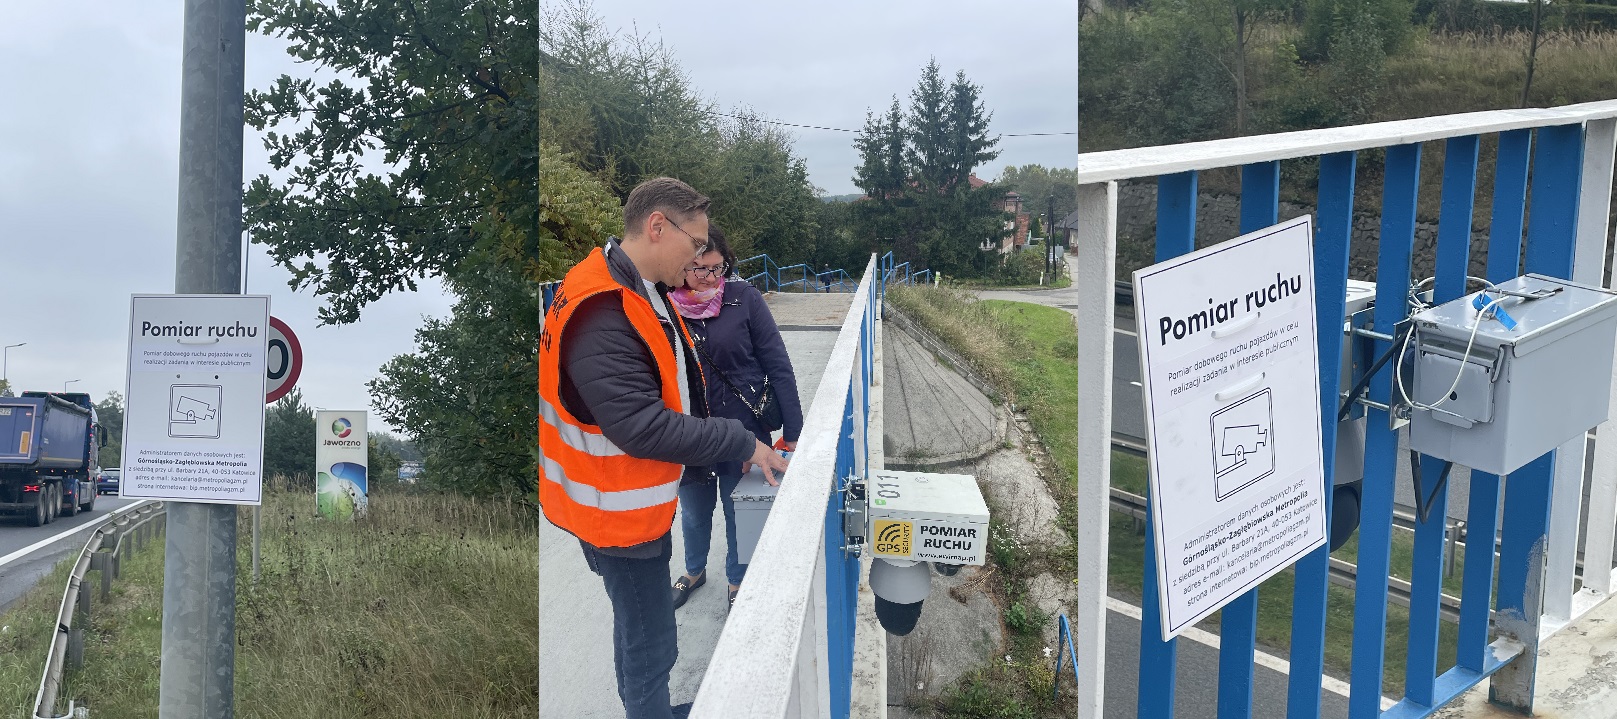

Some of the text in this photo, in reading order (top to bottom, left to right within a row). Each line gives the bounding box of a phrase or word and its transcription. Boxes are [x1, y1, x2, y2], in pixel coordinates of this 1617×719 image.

[1159, 272, 1302, 347] Pomiar ruchu
[141, 320, 258, 337] Pomiar ruchu
[207, 351, 233, 359] pojazdów
[267, 338, 289, 380] 0
[1168, 320, 1299, 382] Pomiar dobowego ruchu pojazdów w celu
[1170, 335, 1299, 397] realizacji zadania w interesie publicznym
[139, 449, 182, 457] Administratorem
[183, 450, 202, 458] danych
[323, 439, 361, 447] Jaworzno
[132, 466, 154, 474] siedzibą
[137, 457, 248, 468] Górnośląsko-Zagłębiowska Metropolia
[1182, 490, 1308, 566] Górnośląsko-Zagłębiowska Metropolia
[1183, 479, 1305, 551] Administratorem danych osobowych jest:
[902, 523, 910, 554] SECURITY
[920, 525, 977, 539] POMIAR
[923, 538, 972, 551] RUCHU
[1172, 497, 1318, 587] z siedzibą przy ul. Barbary 21A, 40-053 Katowice
[876, 543, 901, 553] GPS
[1183, 578, 1202, 595] adres
[1202, 565, 1225, 583] e-mail:
[1187, 527, 1309, 607] strona internetowa: bip.metropoliagzm.pl
